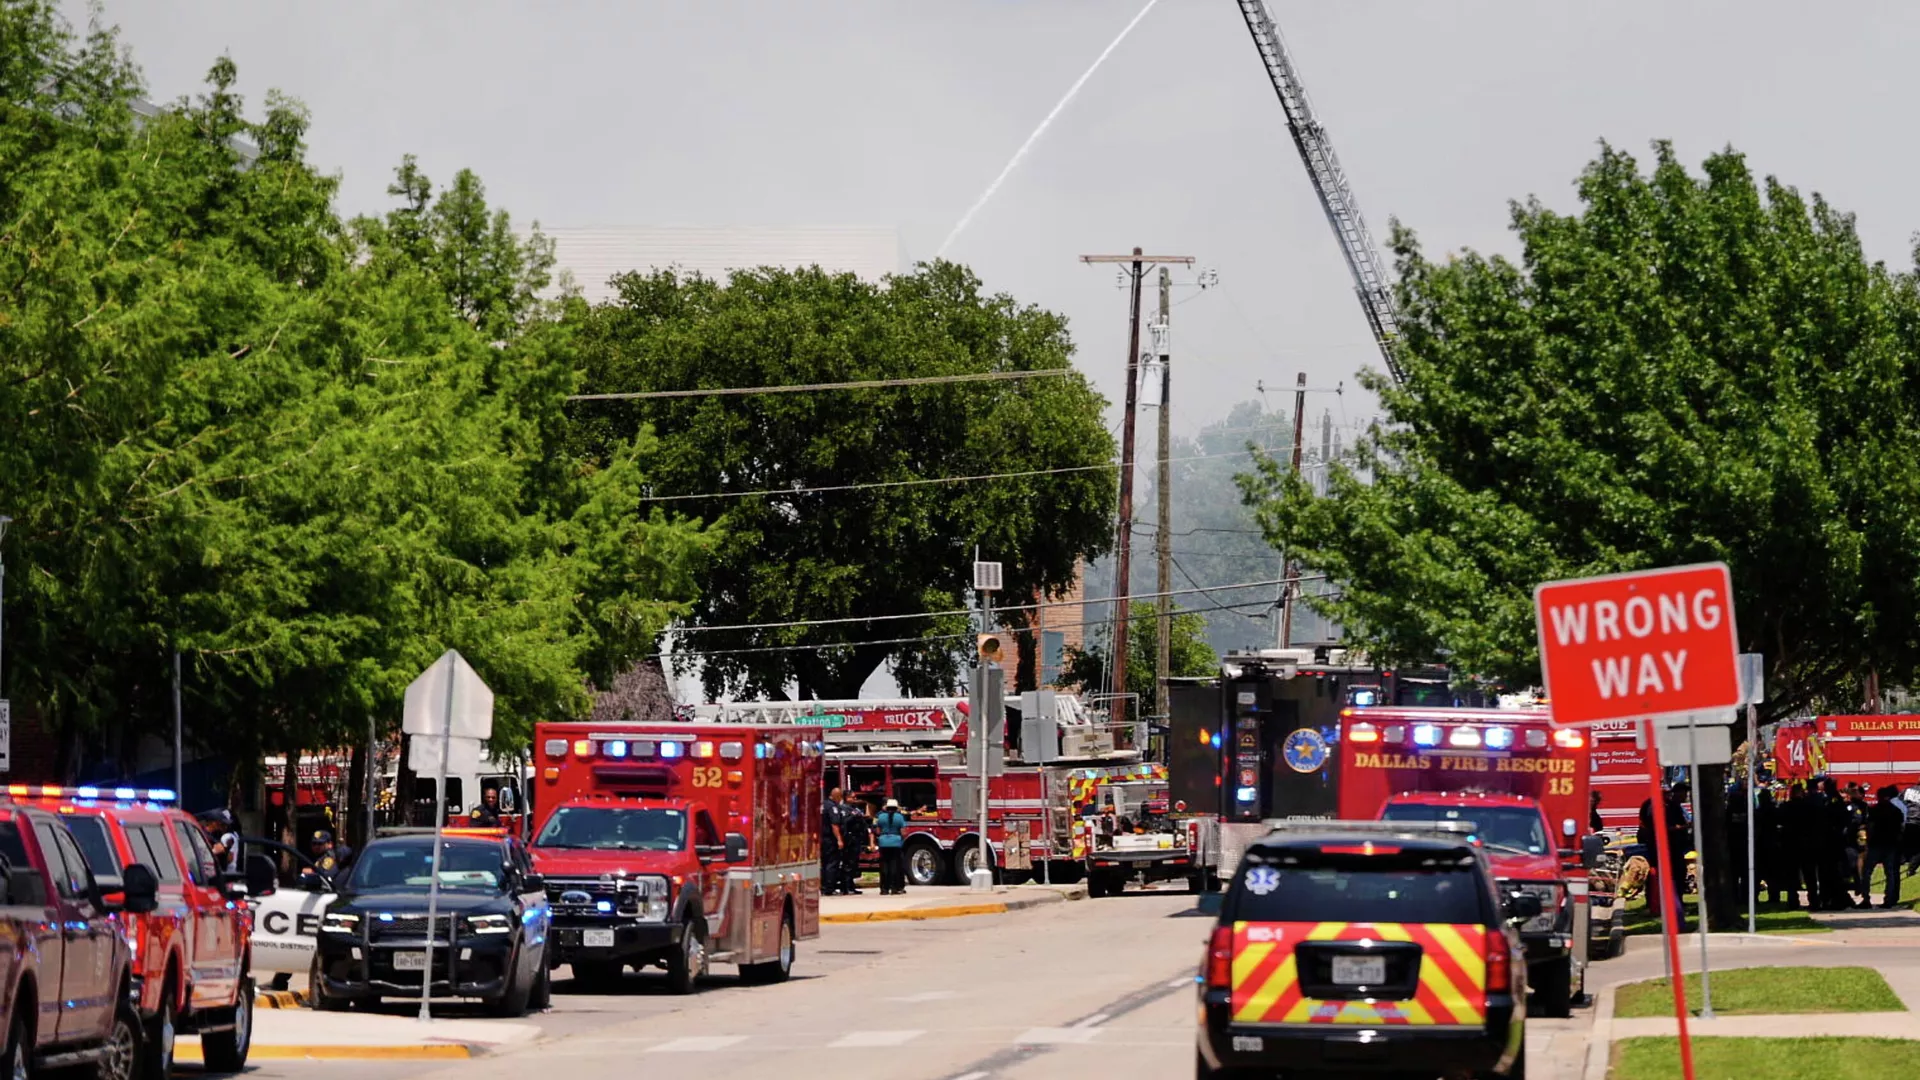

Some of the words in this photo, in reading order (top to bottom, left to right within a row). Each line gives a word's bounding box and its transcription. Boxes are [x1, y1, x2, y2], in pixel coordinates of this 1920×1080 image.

[1550, 588, 1721, 646] WRONG
[1591, 649, 1688, 699] WAY
[885, 711, 936, 727] TRUCK
[1592, 719, 1628, 730] SCUE
[1850, 721, 1894, 730] DALLAS
[1786, 739, 1805, 766] 14
[1355, 753, 1431, 769] DALLAS
[1440, 755, 1488, 772] FIRE
[1496, 757, 1575, 773] RESCUE
[692, 766, 722, 788] 52
[1549, 778, 1574, 795] 15
[251, 940, 278, 950] CHOOL
[280, 942, 315, 951] DISTRICT
